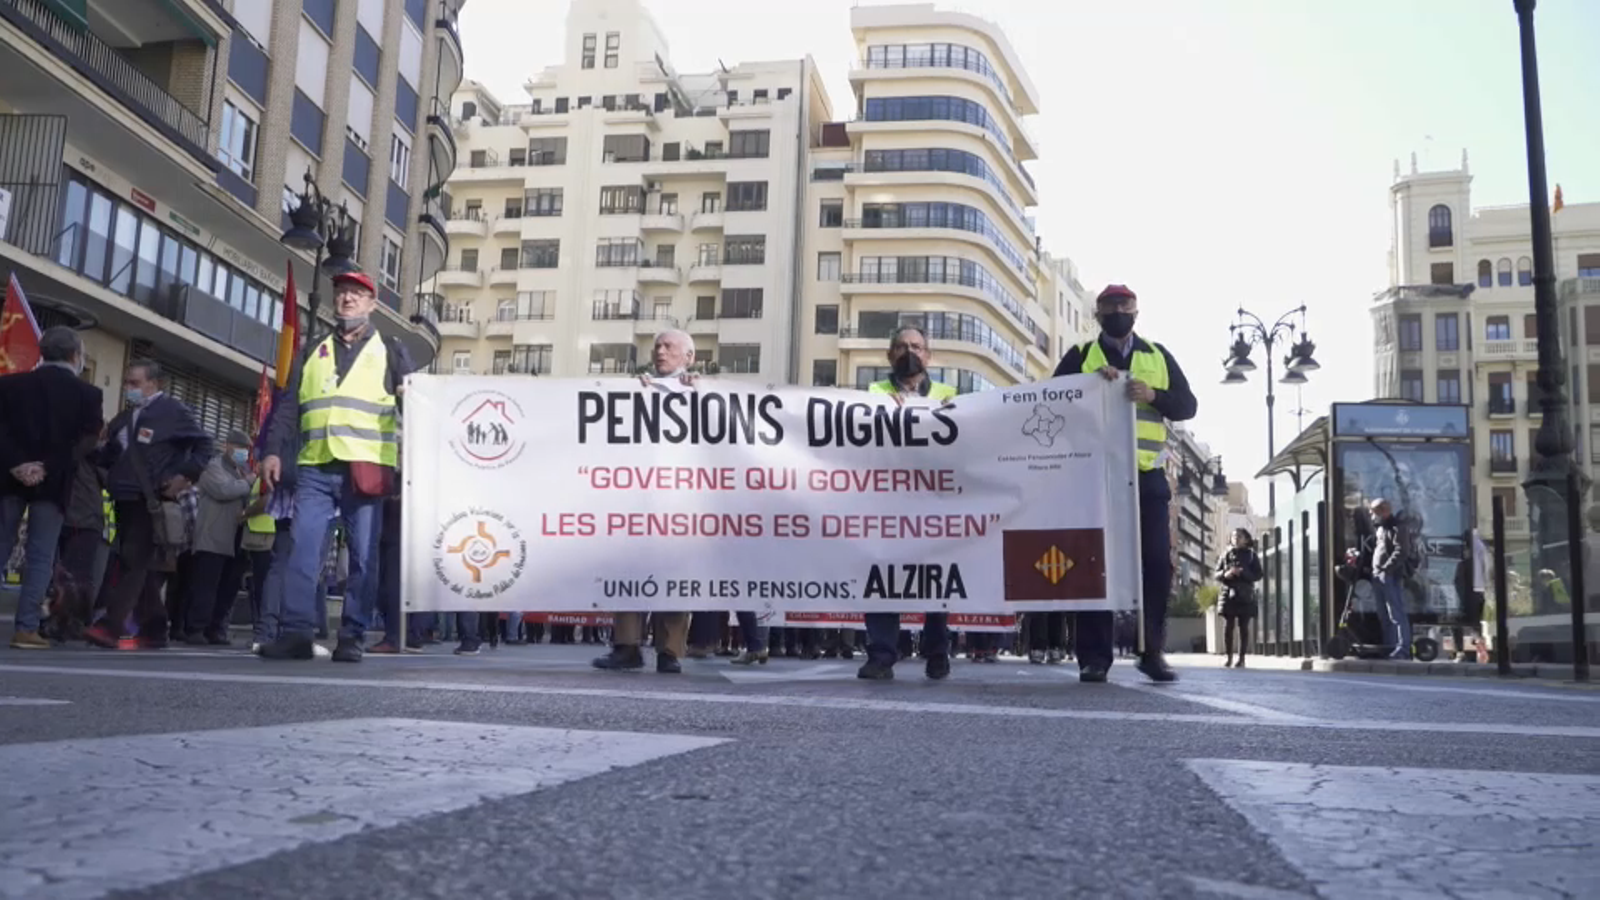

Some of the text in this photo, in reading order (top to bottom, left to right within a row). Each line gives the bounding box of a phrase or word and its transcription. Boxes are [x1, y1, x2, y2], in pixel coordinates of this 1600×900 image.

[1003, 388, 1083, 403] Fem força
[578, 391, 784, 445] PENSIONS
[807, 397, 959, 447] DIGNES
[746, 467, 797, 491] QUI
[808, 469, 963, 494] GOVERNE,
[541, 513, 596, 536] LES
[607, 513, 763, 537] PENSIONS
[774, 514, 810, 538] ES
[667, 580, 701, 597] PER
[709, 580, 740, 597] LES
[863, 563, 967, 599] ALZIRA
[957, 615, 1000, 624] ALZIRA
